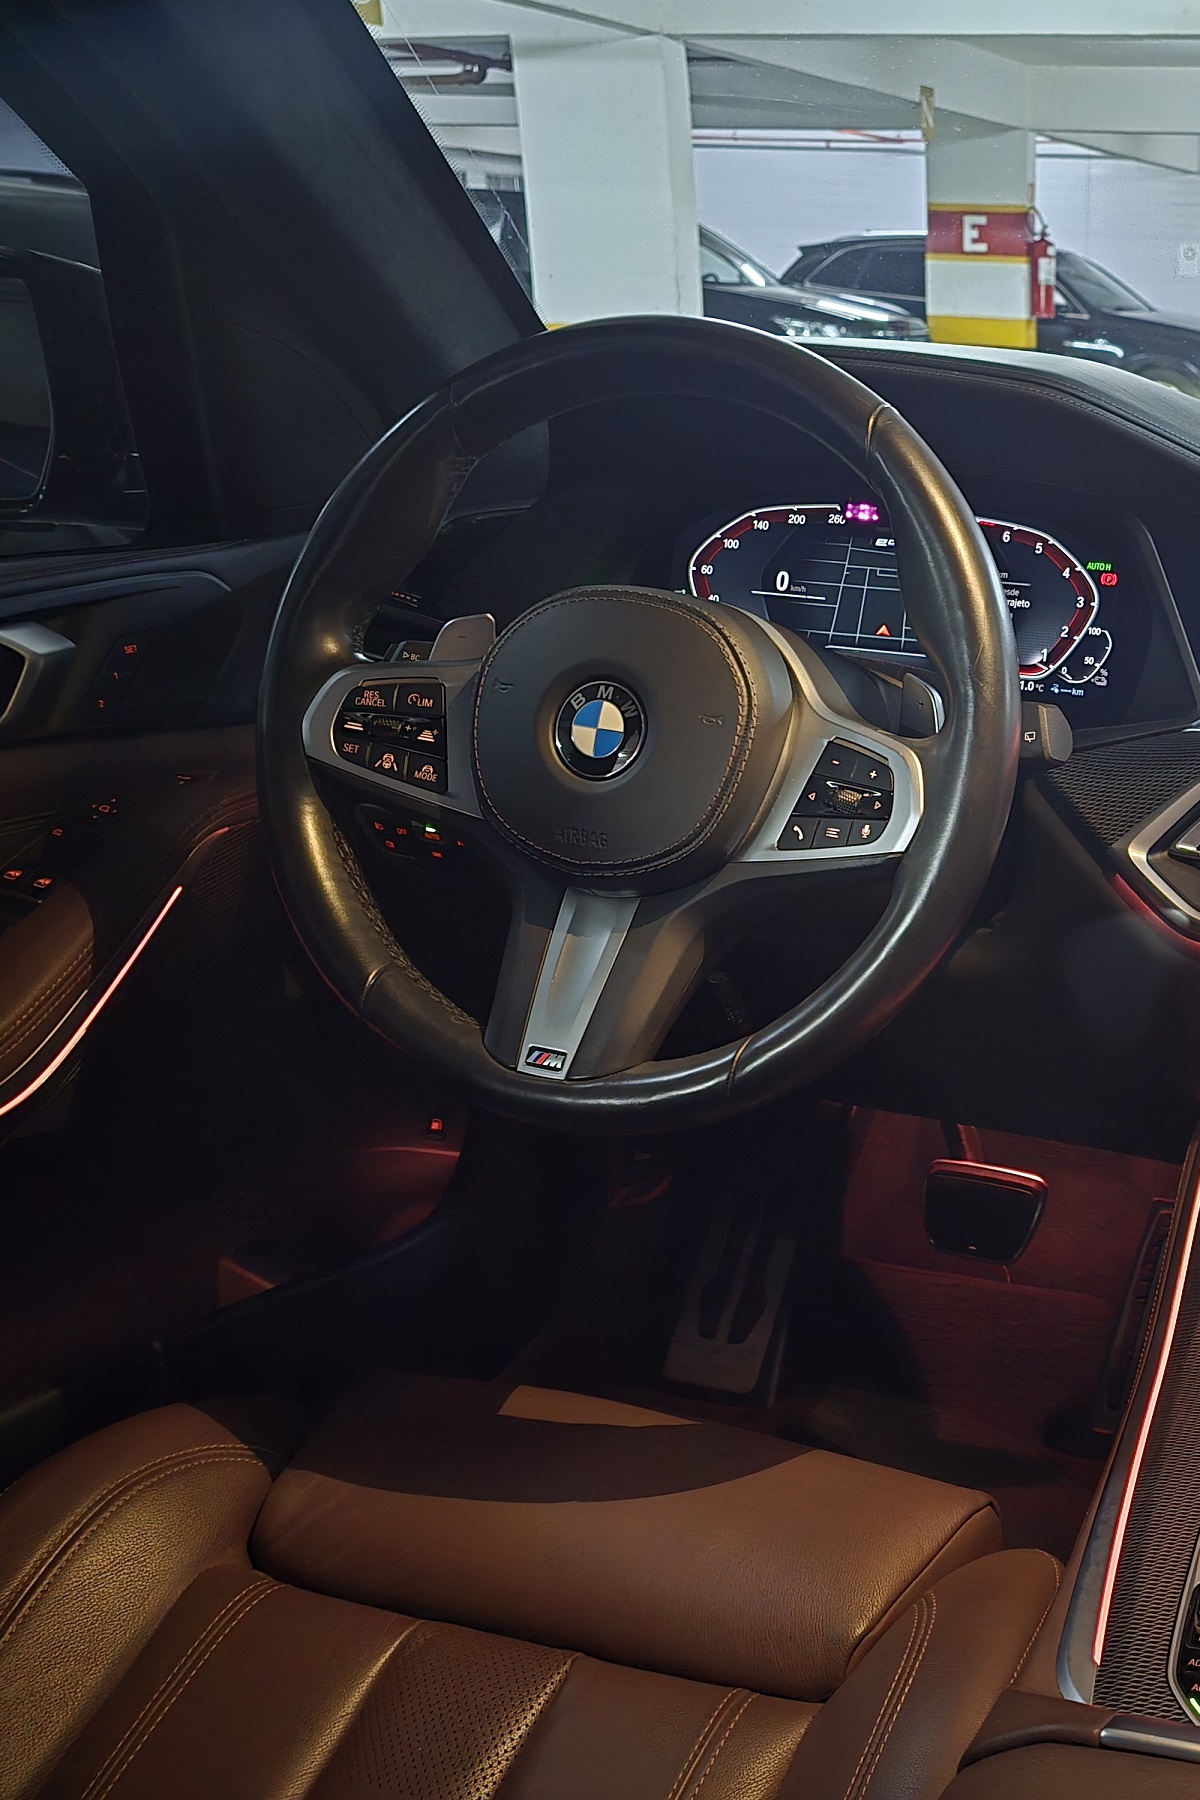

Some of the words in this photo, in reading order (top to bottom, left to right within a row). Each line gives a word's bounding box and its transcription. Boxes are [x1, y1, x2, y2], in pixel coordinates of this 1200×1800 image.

[962, 214, 989, 253] E
[788, 515, 806, 524] 200
[828, 514, 845, 524] 260
[753, 520, 769, 531] 140
[1002, 531, 1011, 542] 6
[723, 539, 739, 549] 100
[1035, 543, 1043, 554] 5
[701, 565, 713, 575] 60
[1087, 562, 1104, 571] AUTO
[1062, 568, 1071, 579] 4
[776, 570, 790, 591] 0
[790, 585, 807, 593] km/h
[1076, 597, 1085, 608] 3
[1061, 627, 1069, 638] 2
[1088, 628, 1101, 636] 100
[1041, 649, 1048, 662] 1
[1084, 656, 1094, 665] 50
[1061, 667, 1067, 675] 0
[364, 690, 379, 700] RES
[355, 697, 386, 708] CANCEL
[417, 697, 433, 708] LIM
[571, 686, 638, 719] BMW
[343, 743, 360, 754] SET
[414, 771, 438, 782] MODE
